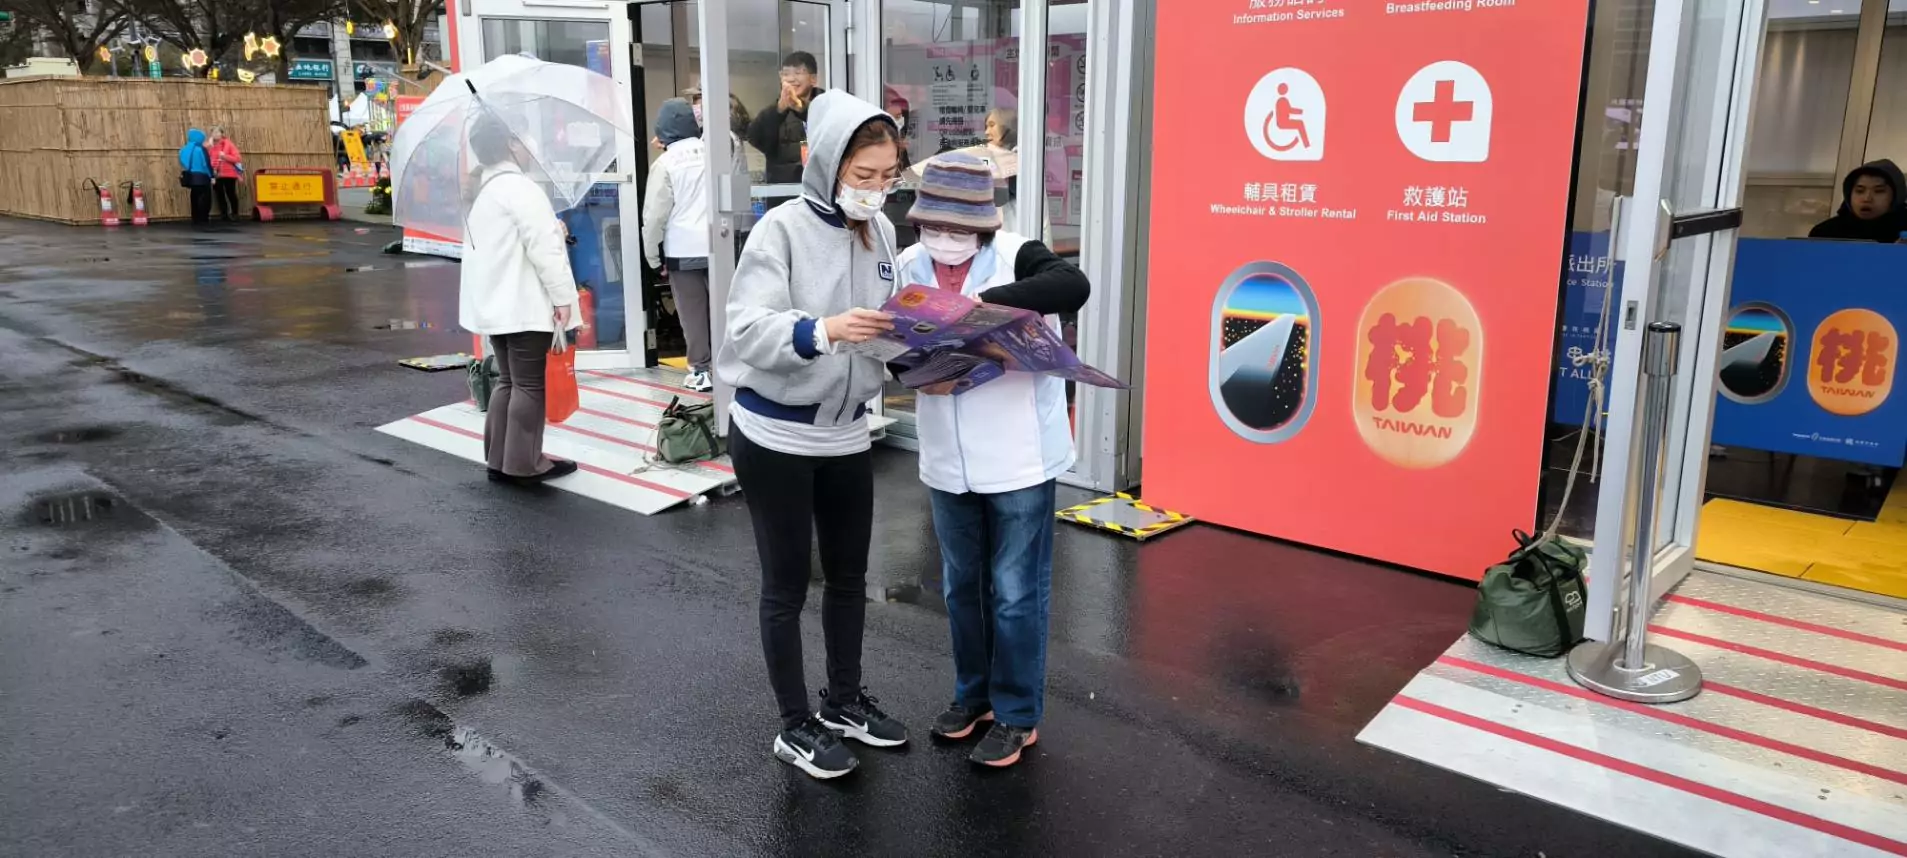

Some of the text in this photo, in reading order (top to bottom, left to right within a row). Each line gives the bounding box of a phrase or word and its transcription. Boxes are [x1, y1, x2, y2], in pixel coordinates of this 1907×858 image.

[1386, 0, 1472, 13] Breastfeeding
[1233, 8, 1345, 24] Information Services
[1243, 182, 1317, 203] 輔具租賃
[1403, 186, 1468, 208] 救護站
[1210, 204, 1356, 219] Wheelchair & Stroller Rental
[1387, 210, 1486, 223] First Aid Station
[1581, 278, 1614, 288] Statio
[1821, 386, 1876, 398] TAIWAN
[1372, 416, 1452, 439] TAIWAN
